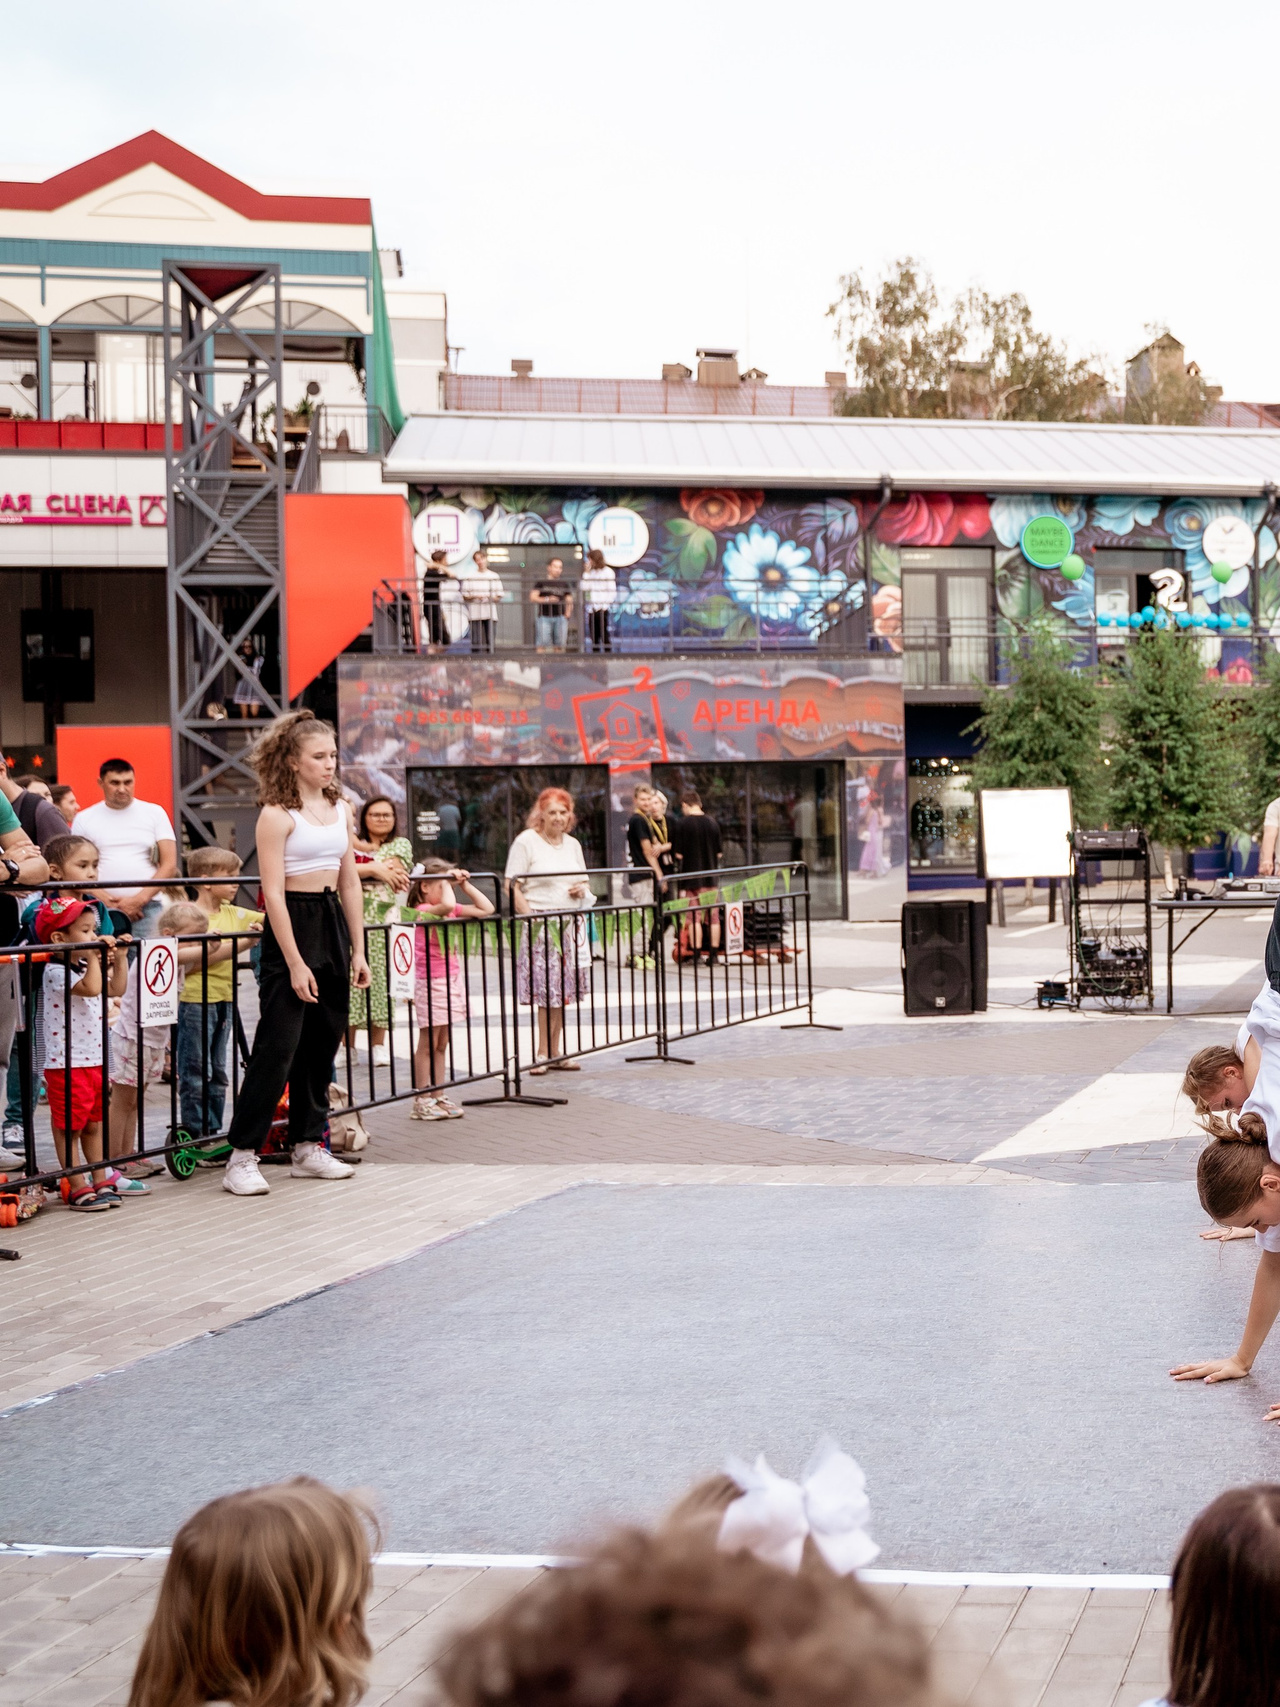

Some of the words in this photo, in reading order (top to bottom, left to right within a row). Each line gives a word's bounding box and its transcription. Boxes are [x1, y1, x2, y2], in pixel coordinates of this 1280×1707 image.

[0, 493, 32, 512] АЯ
[46, 493, 132, 517] СЦЕНА
[1030, 527, 1064, 536] MAYBE
[1030, 538, 1064, 547] DANCE
[393, 710, 414, 725] +7
[417, 710, 449, 725] 965
[452, 709, 484, 725] 669
[487, 709, 507, 725] 75
[510, 709, 529, 725] 15
[692, 699, 821, 728] АРЕНДА
[149, 1001, 170, 1010] ПРОХОД
